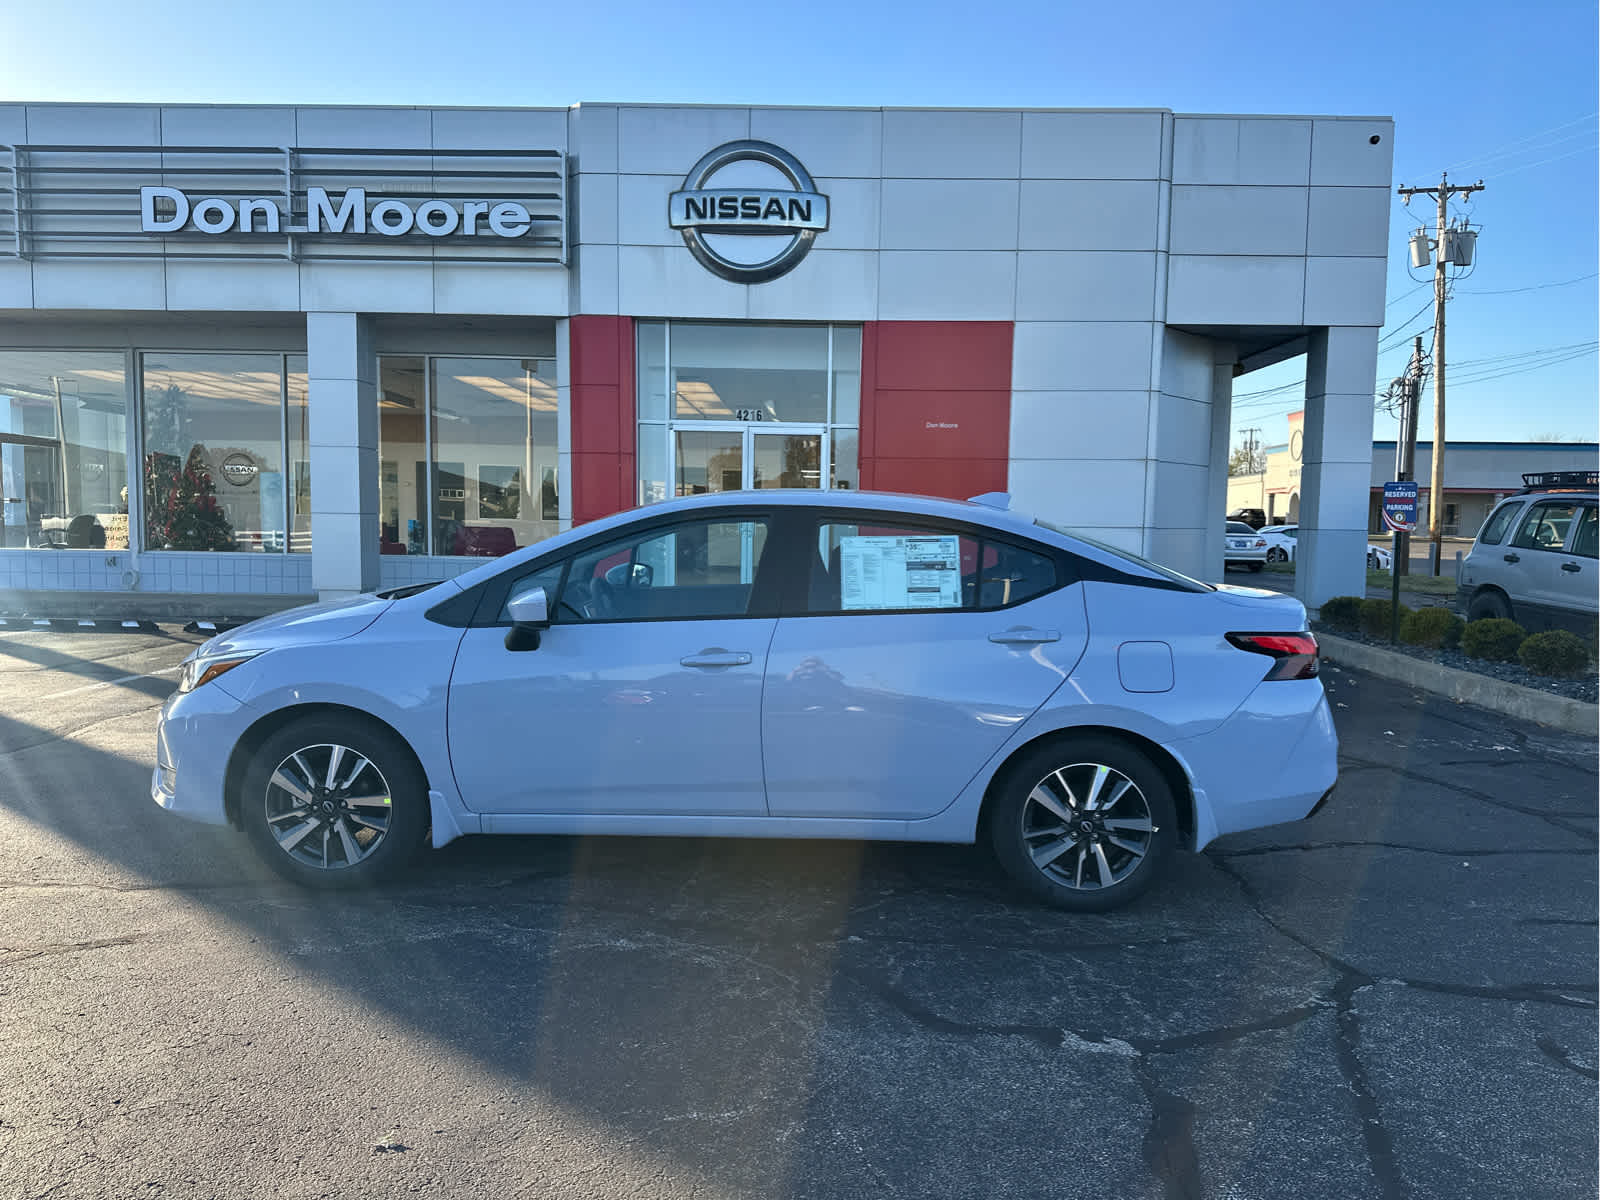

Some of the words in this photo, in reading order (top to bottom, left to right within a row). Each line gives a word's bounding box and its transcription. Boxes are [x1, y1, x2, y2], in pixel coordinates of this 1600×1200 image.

[139, 185, 280, 234] Don
[307, 186, 531, 238] Moore
[684, 196, 812, 222] NISSAN
[736, 409, 762, 421] 4216
